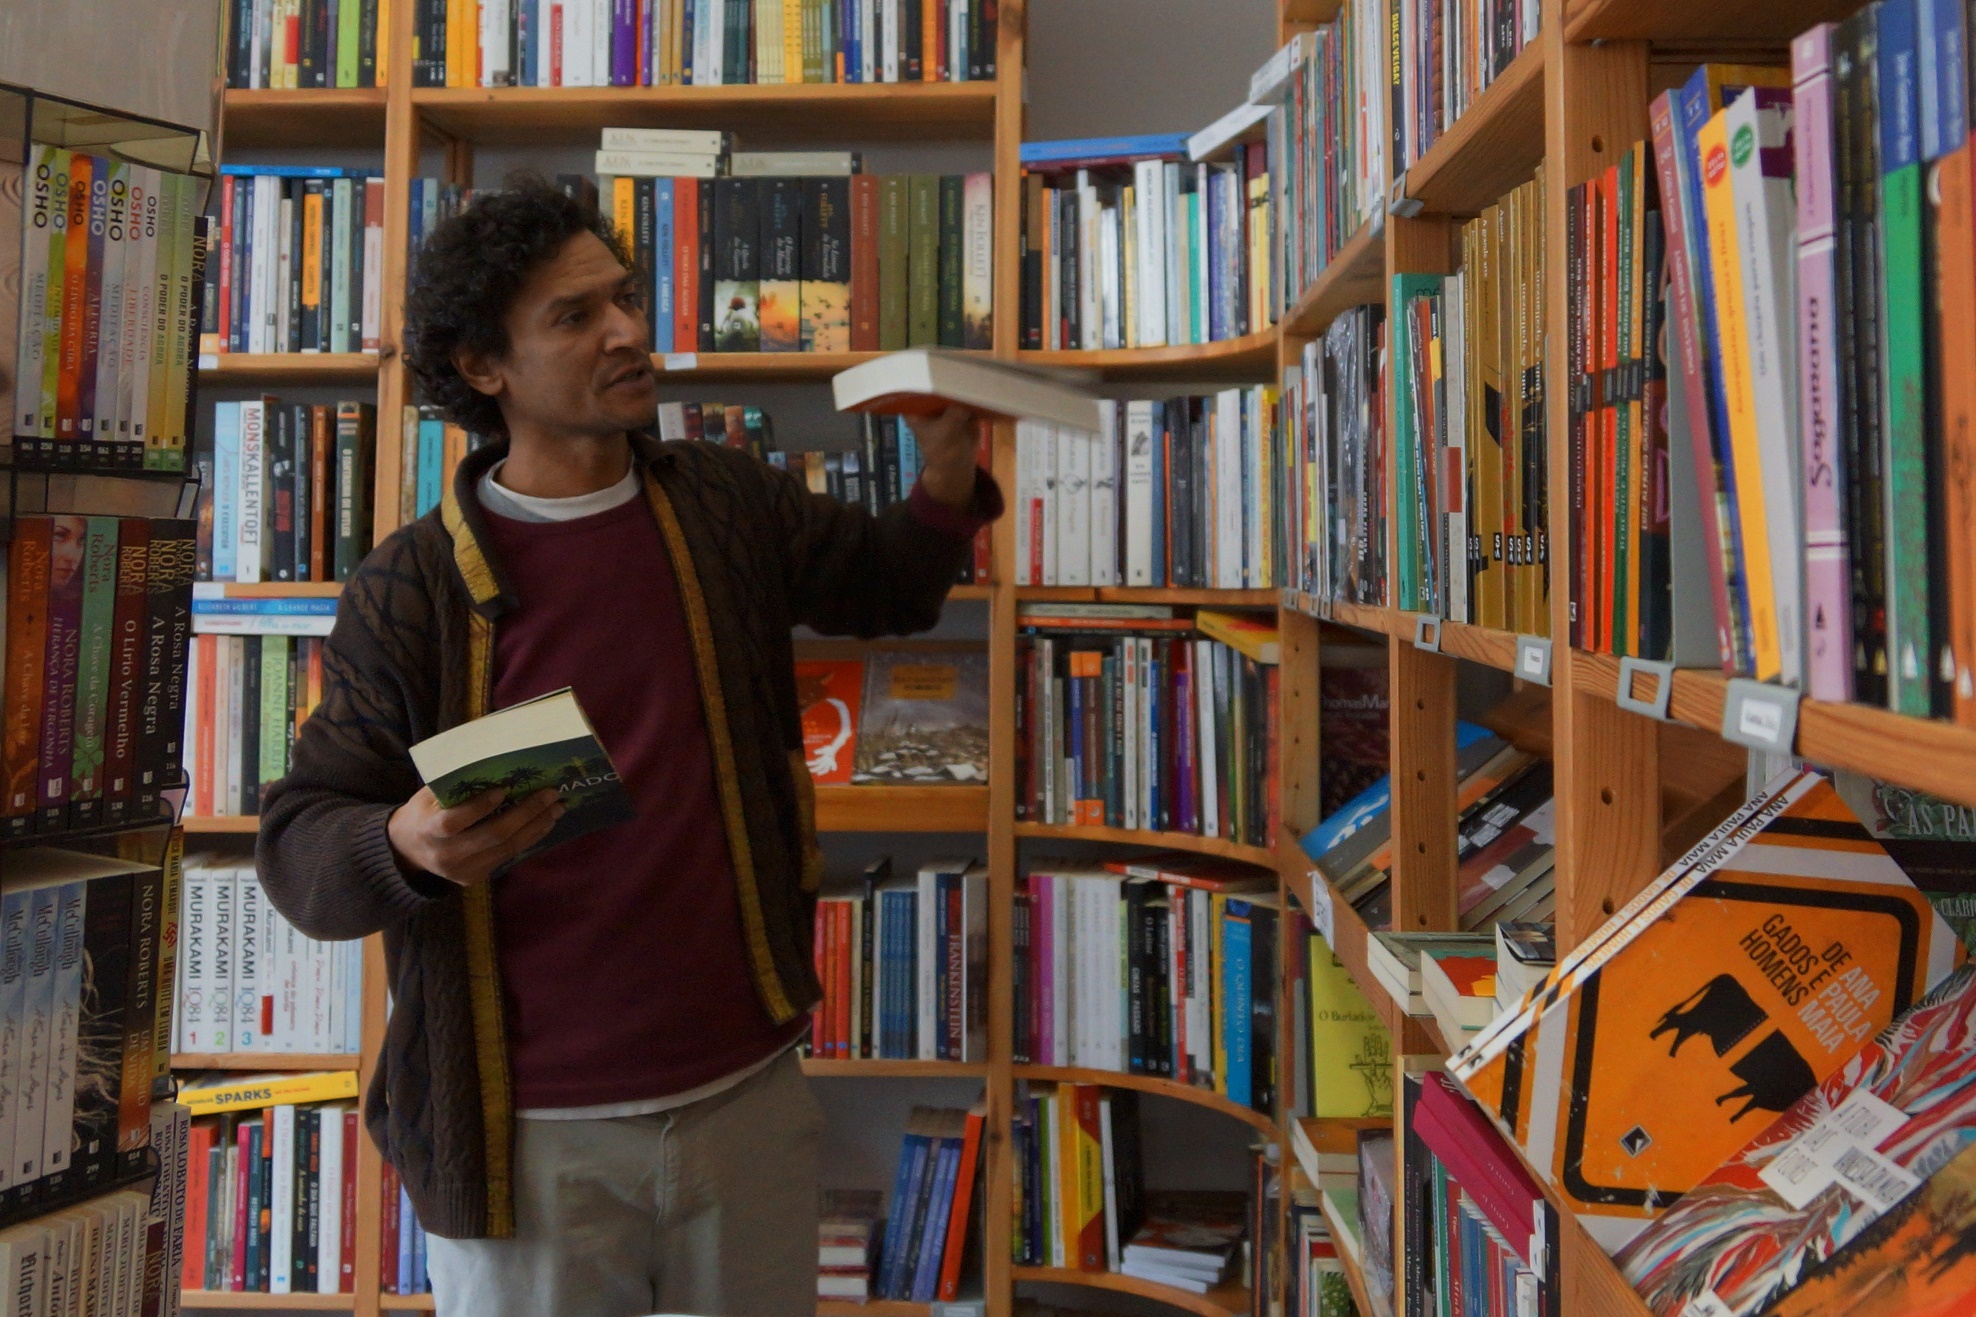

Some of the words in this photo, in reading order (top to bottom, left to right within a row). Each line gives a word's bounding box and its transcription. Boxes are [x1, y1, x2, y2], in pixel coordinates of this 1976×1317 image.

[34, 163, 50, 229] OSHO
[54, 172, 68, 230] OSHO
[73, 181, 86, 226] OSHO
[92, 179, 107, 236] OSHO
[109, 179, 126, 242] OSHO
[129, 186, 144, 241] OSHO
[145, 196, 157, 238] OSHO
[192, 235, 207, 282] NORA
[69, 285, 79, 319] LIVRO
[159, 282, 168, 315] PODER
[179, 285, 188, 317] PODER
[157, 317, 167, 331] DO
[177, 319, 187, 332] DO
[66, 341, 76, 370] CURA
[154, 333, 166, 365] AGORA
[175, 334, 186, 366] AGORA
[19, 540, 37, 602] Roberts
[33, 551, 48, 591] Nora
[87, 533, 104, 594] Roberts
[102, 543, 116, 583] Nora
[117, 546, 132, 596] ROBERTS
[129, 546, 147, 596] NORA
[147, 539, 161, 594] ROBERTS
[158, 540, 177, 593] NORA
[178, 539, 196, 587] NORA
[124, 619, 137, 633] O
[152, 616, 164, 628] A
[175, 605, 187, 616] A
[62, 629, 77, 678] NORA
[148, 634, 164, 675] Rosa
[172, 622, 185, 658] Rosa
[167, 663, 184, 710] Negra
[58, 683, 75, 755] ROBERTS
[115, 679, 133, 758] Vermelho
[144, 680, 161, 735] Negra
[44, 699, 58, 768] VERGONHA
[1743, 791, 1769, 811] ANA
[1763, 795, 1789, 818] ANA
[1908, 803, 1934, 836] AS
[1709, 812, 1745, 841] PAULA
[1727, 817, 1765, 848] PAULA
[1679, 841, 1711, 867] MAIA
[1695, 847, 1730, 874] MAIA
[1624, 883, 1662, 914] GADOS
[1678, 875, 1695, 890] DE
[139, 884, 154, 933] NORA
[1640, 889, 1679, 921] GADOS
[2, 908, 25, 985] McCullough
[32, 903, 53, 978] McCullough
[60, 897, 82, 971] McCullough
[189, 885, 203, 979] MURAKAMI
[216, 885, 230, 979] MURAKAMI
[242, 885, 256, 979] MURAKAMI
[1762, 913, 1819, 976] GADOS
[1808, 968, 1832, 991] E
[135, 938, 152, 1009] ROBERTS
[1739, 928, 1810, 1007] HOMENS
[1821, 940, 1853, 973] DE
[182, 985, 203, 1024] 1Q84
[208, 985, 229, 1024] 1Q84
[236, 985, 256, 1024] 1Q84
[949, 934, 962, 1038] FRANKENSTEIN
[1838, 965, 1882, 1011] ANA
[160, 1006, 172, 1018] EM
[1797, 999, 1846, 1055] MAIA
[1818, 981, 1872, 1043] PAULA
[158, 1021, 171, 1052] LISBOA
[190, 1031, 197, 1045] 1
[214, 1031, 225, 1046] 2
[241, 1031, 252, 1046] 3
[215, 1088, 272, 1105] SPARKS
[164, 1123, 172, 1153] ROSA
[179, 1120, 188, 1149] ROSA
[175, 1150, 188, 1206] LOBATO
[120, 1217, 131, 1256] MARIA
[174, 1208, 184, 1225] DE
[105, 1223, 114, 1263] MARIA
[171, 1227, 184, 1267] FARIA
[101, 1266, 112, 1307] JUDITE
[117, 1260, 127, 1304] JUDITE
[133, 1254, 144, 1296] JUDITE
[86, 1277, 97, 1317] MAR
